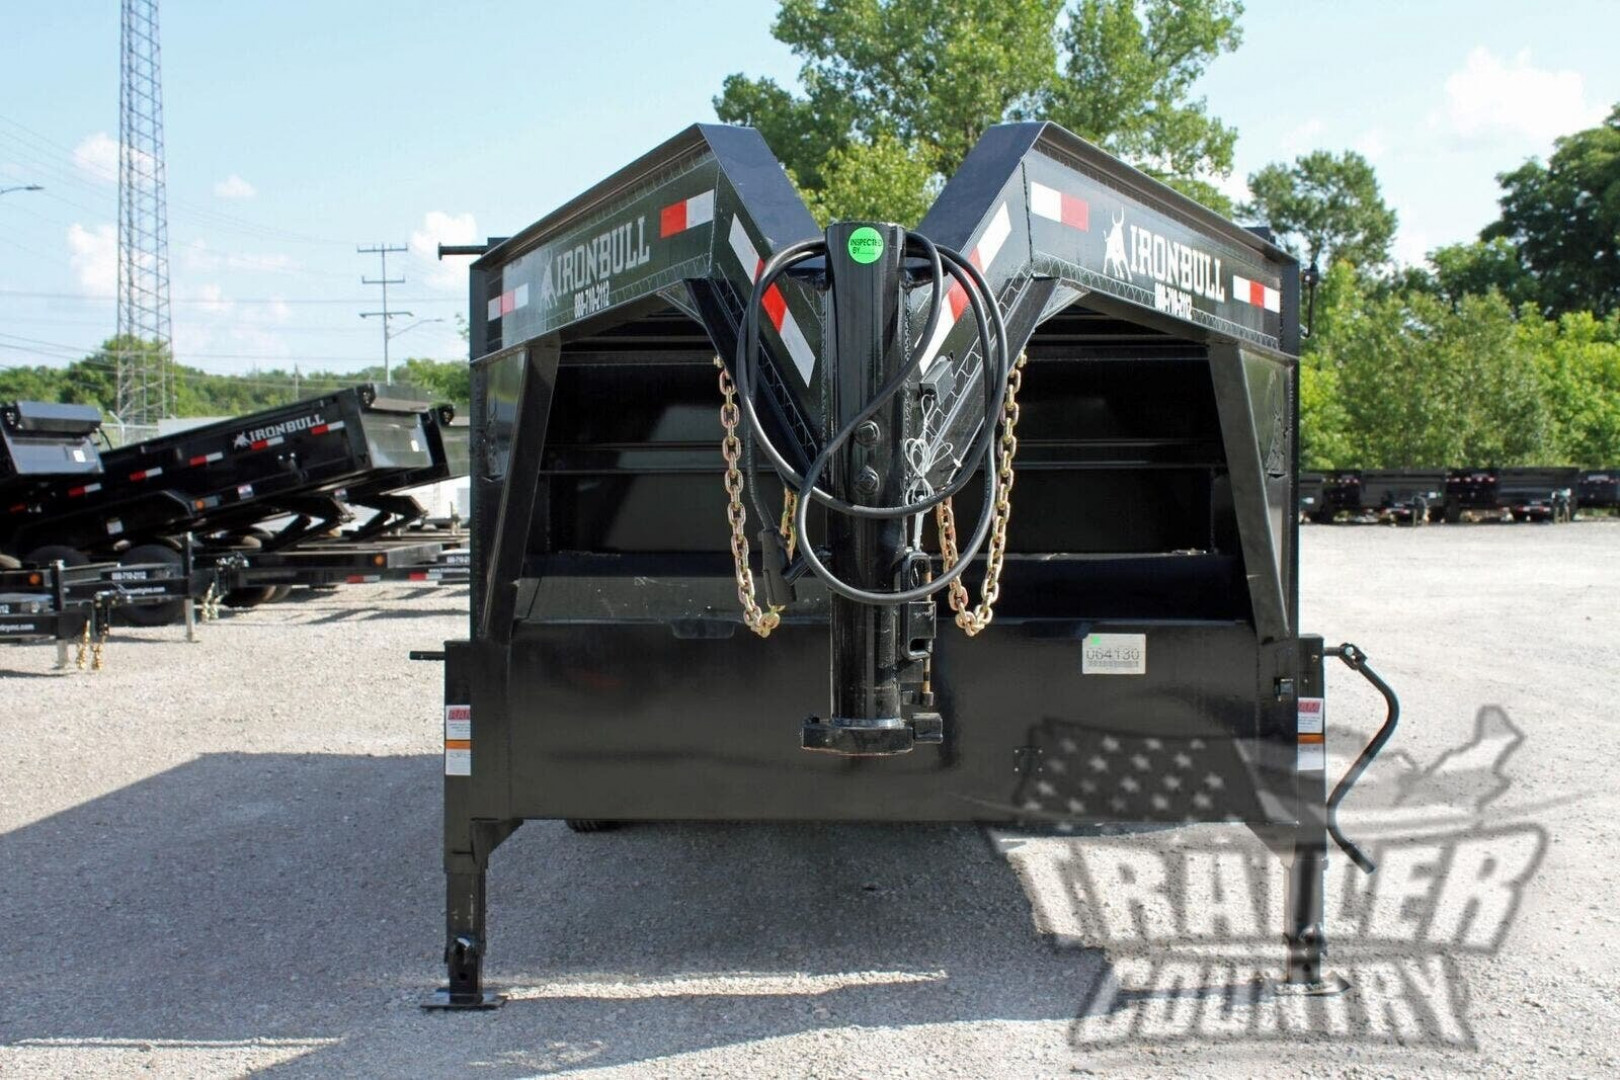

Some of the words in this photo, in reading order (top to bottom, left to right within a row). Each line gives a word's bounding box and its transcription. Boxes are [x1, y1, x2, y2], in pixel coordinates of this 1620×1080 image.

[556, 216, 650, 296] IRONBULL
[850, 238, 883, 247] INSPECTED
[1130, 225, 1225, 303] IRONBULL
[249, 413, 325, 442] IRONBULL
